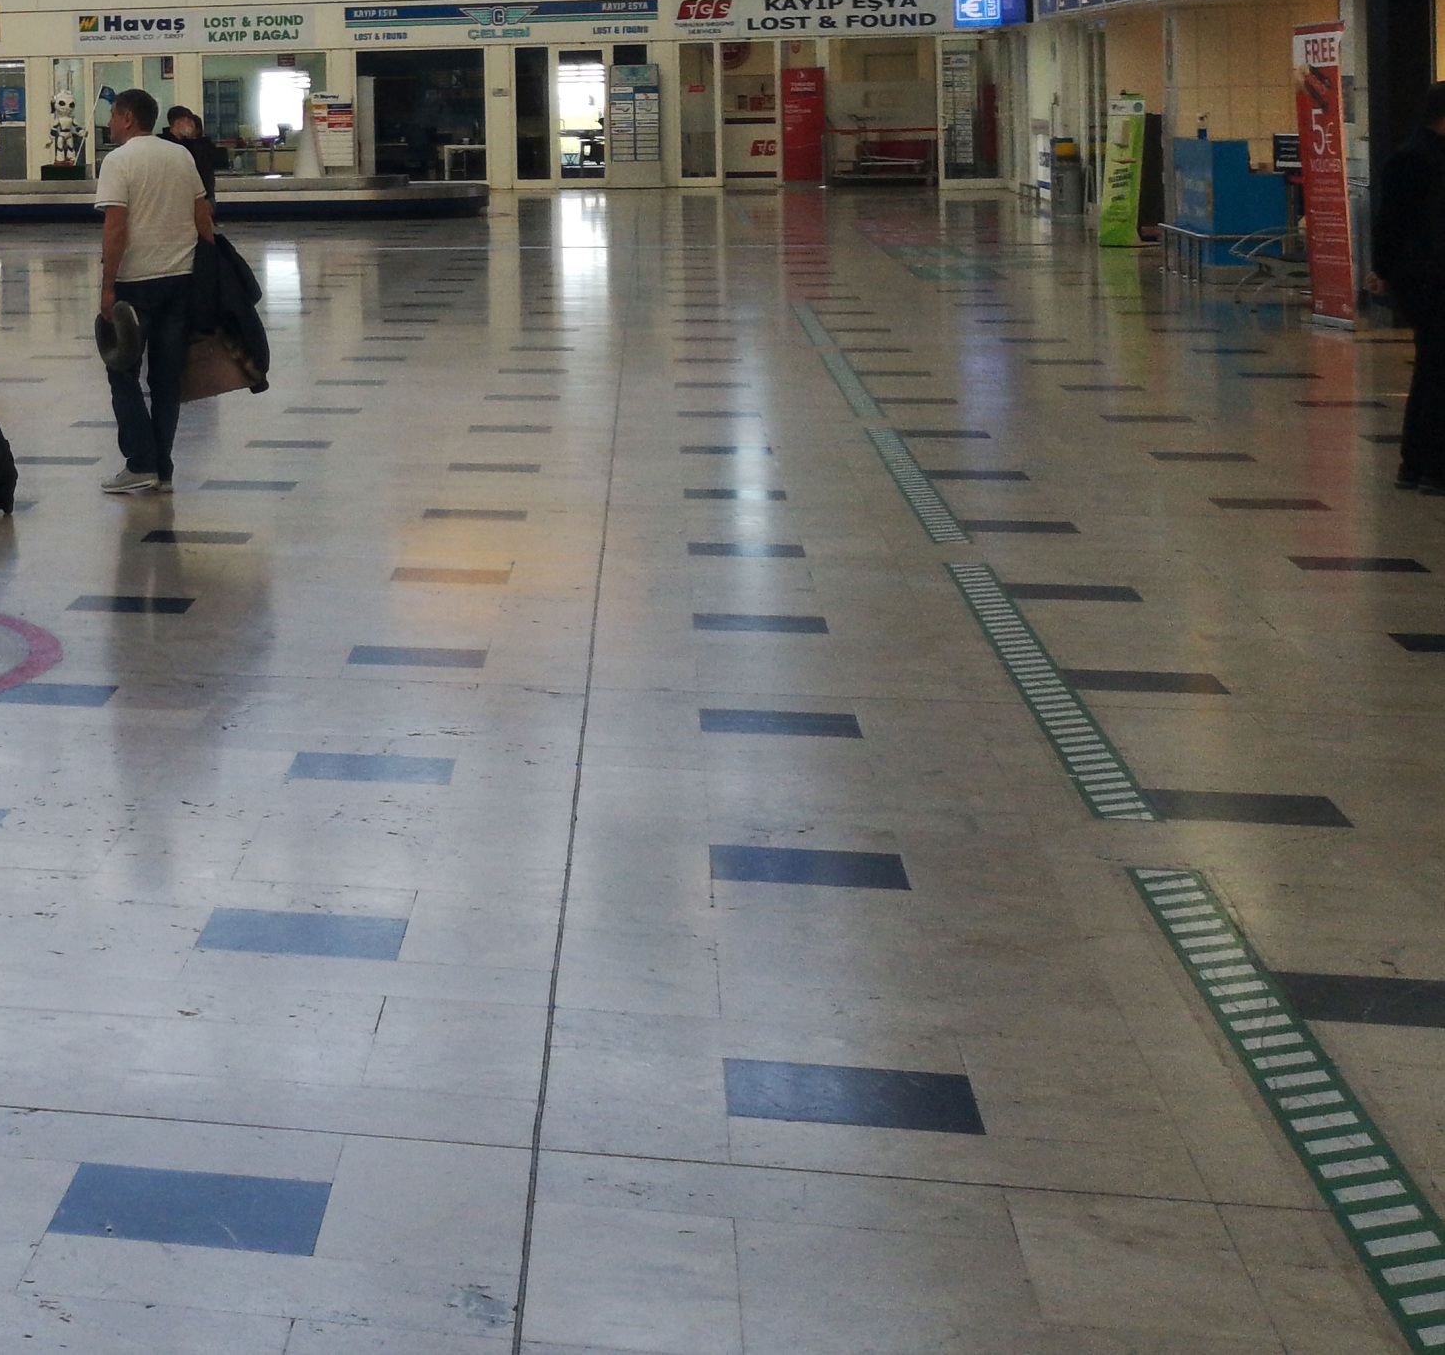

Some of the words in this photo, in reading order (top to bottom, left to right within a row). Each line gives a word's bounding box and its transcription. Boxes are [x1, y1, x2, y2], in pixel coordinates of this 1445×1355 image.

[681, 0, 730, 17] TGS
[104, 15, 186, 34] Havaş
[203, 16, 236, 28] LOST
[241, 16, 252, 28] &
[256, 15, 304, 27] FOUND
[747, 16, 812, 31] LOST
[818, 16, 837, 29] &
[846, 13, 937, 29] FOUND
[208, 31, 247, 43] KAYIP
[252, 29, 299, 41] BAGAJ
[354, 33, 373, 41] LOST
[592, 26, 611, 35] LOST
[1304, 37, 1336, 64] FREE
[1311, 108, 1337, 156] 5€
[1310, 158, 1342, 173] VOUCHER
